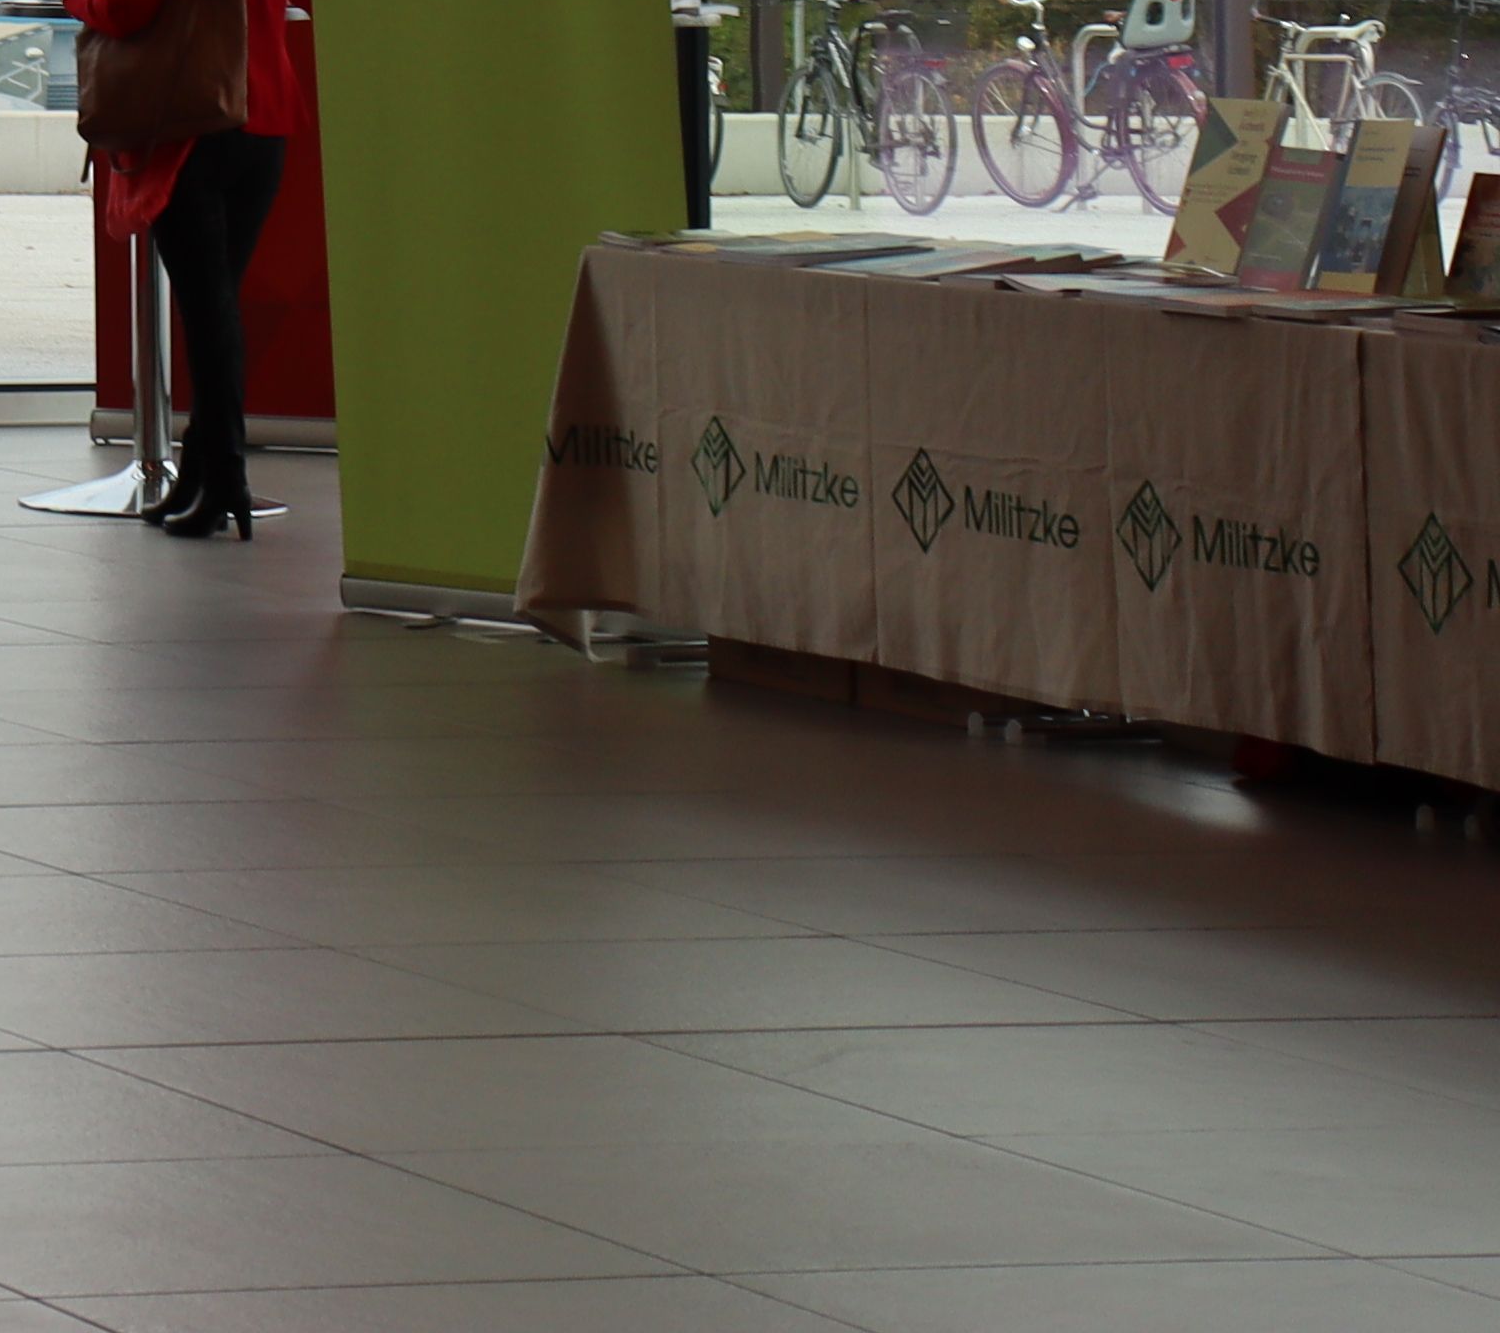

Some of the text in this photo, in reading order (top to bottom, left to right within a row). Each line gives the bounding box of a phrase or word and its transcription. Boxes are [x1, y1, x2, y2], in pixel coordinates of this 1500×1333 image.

[755, 452, 859, 508] Militzke
[965, 486, 1079, 548] Militzke
[1193, 516, 1320, 576] Militzke
